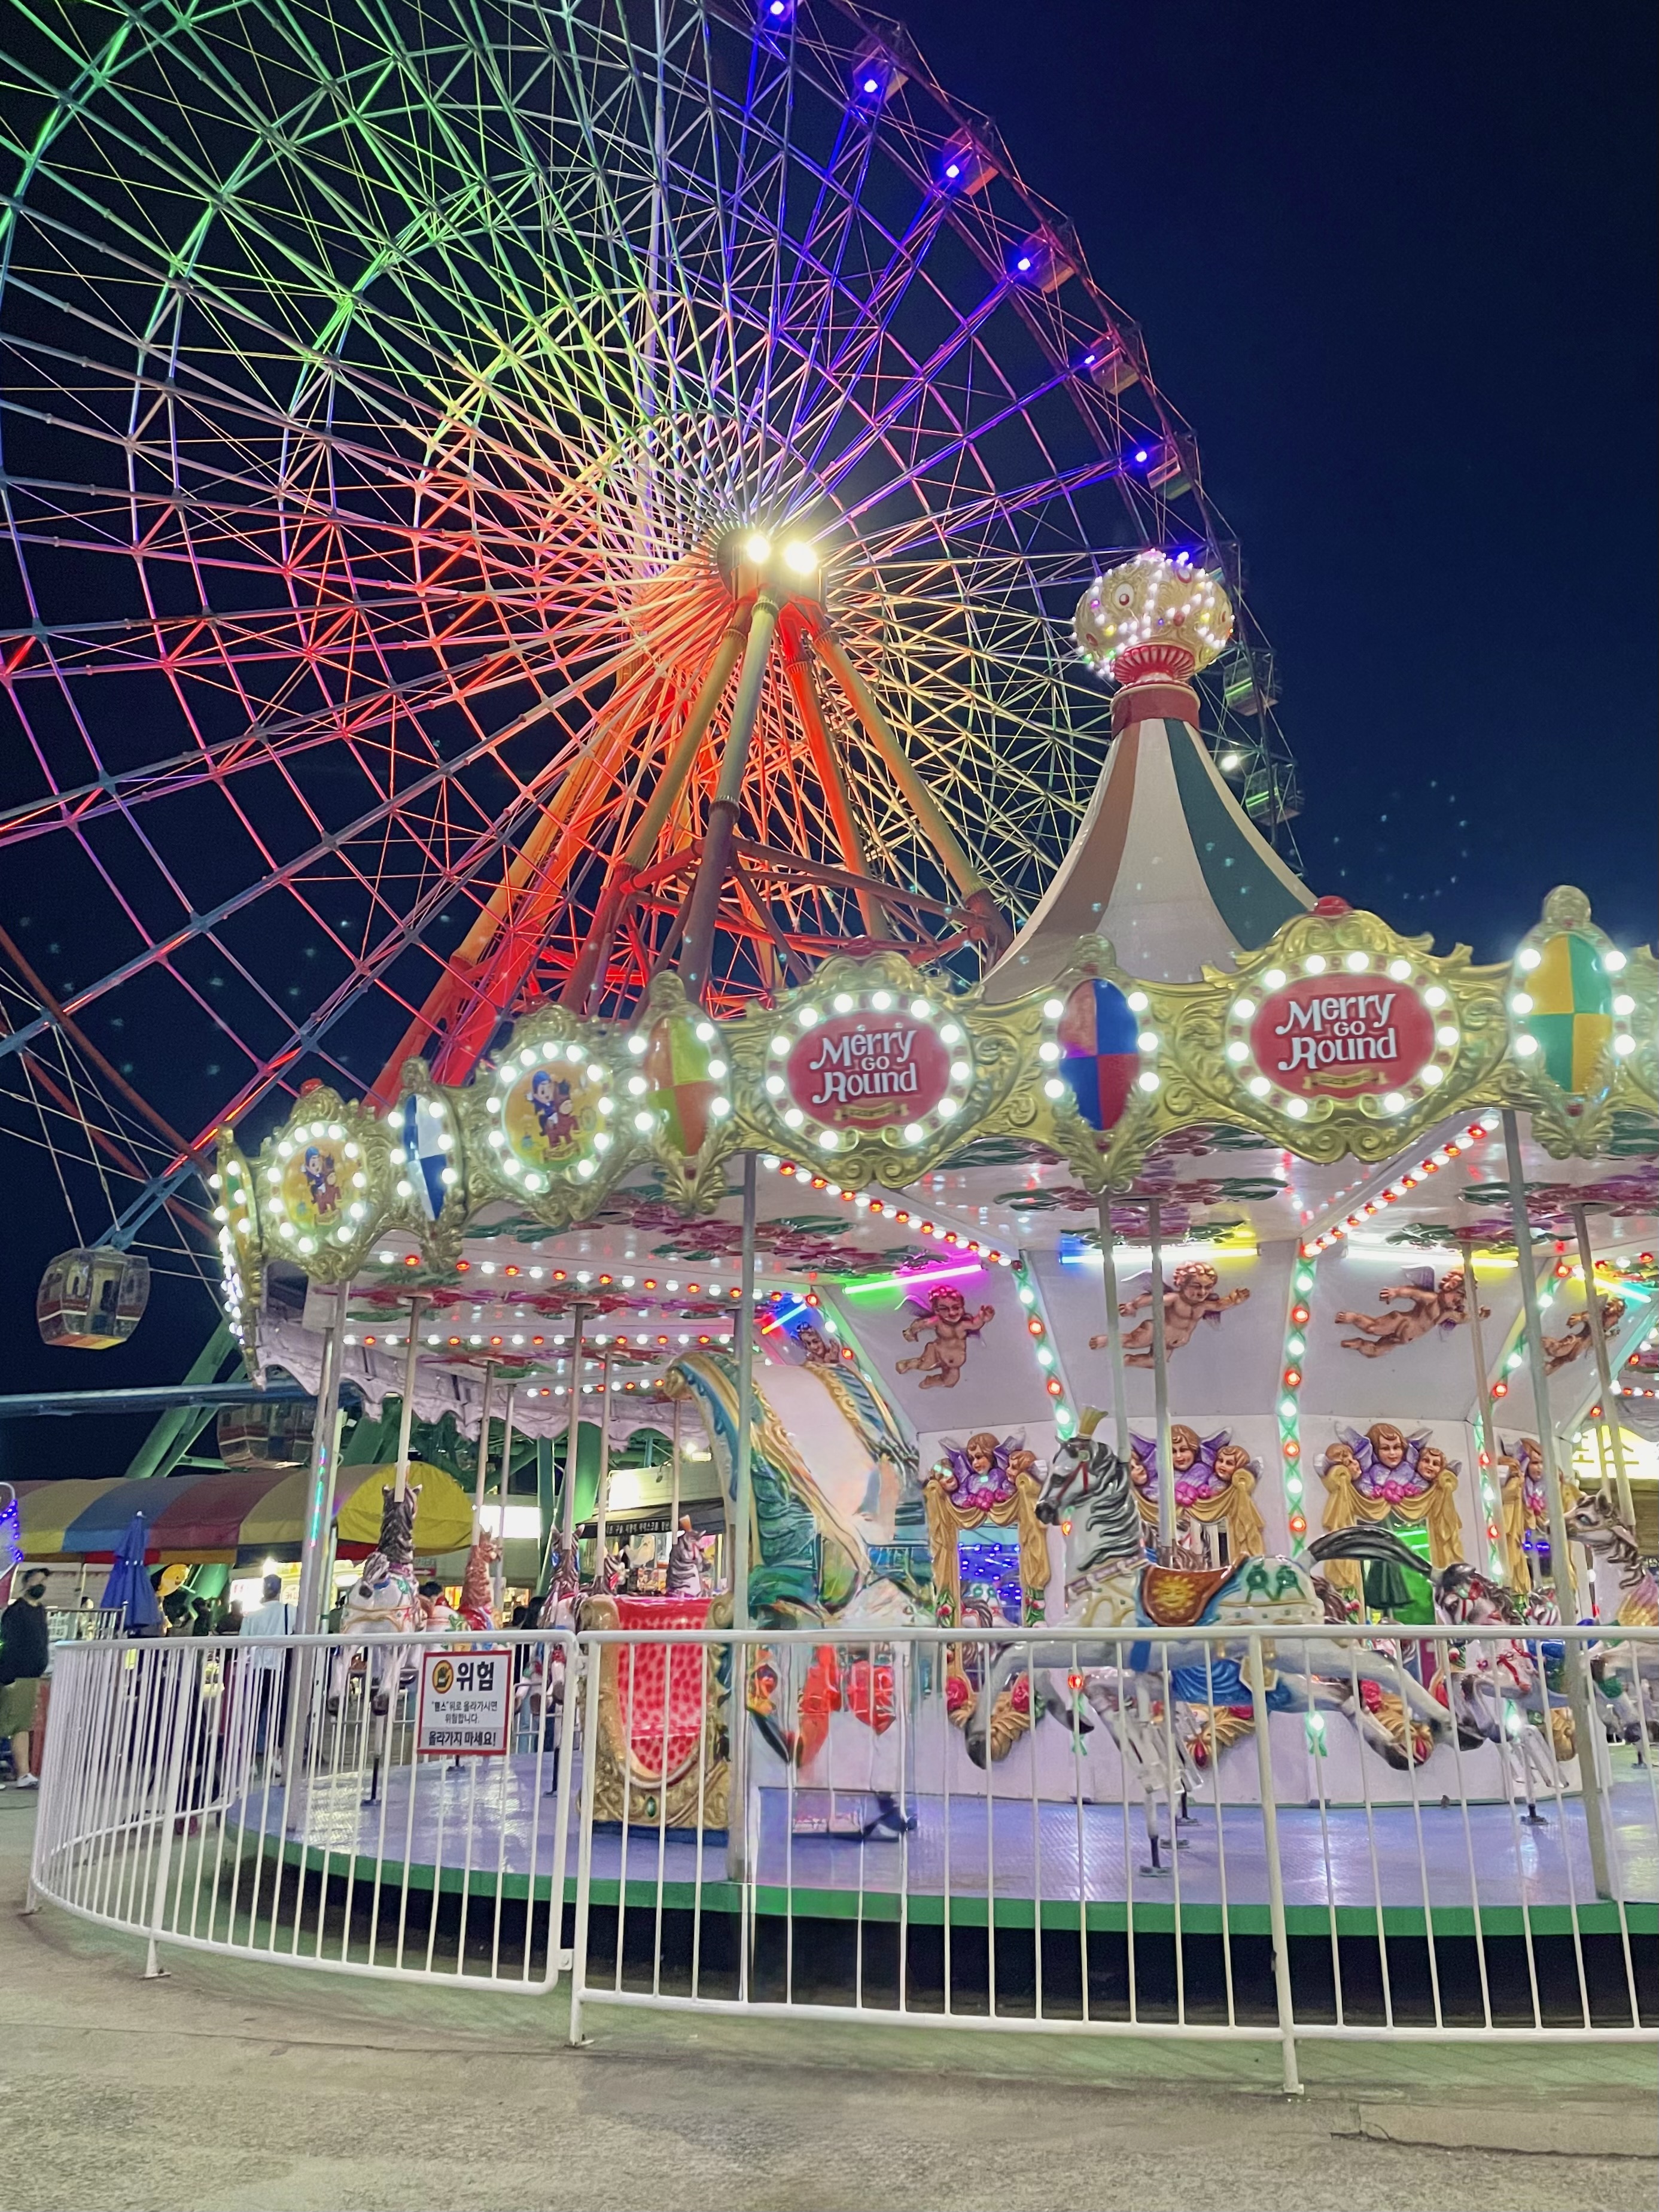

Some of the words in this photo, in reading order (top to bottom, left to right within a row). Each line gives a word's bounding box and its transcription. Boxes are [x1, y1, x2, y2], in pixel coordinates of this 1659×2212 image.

[1274, 993, 1396, 1035] Merry
[1334, 1021, 1366, 1036] GO
[809, 1030, 918, 1070] Merry
[1277, 1027, 1398, 1071] Round
[861, 1055, 890, 1071] GO
[812, 1062, 918, 1104] Round
[456, 1661, 495, 1691] 위험
[463, 1700, 498, 1712] 올라가시면
[445, 1713, 479, 1724] 위험합니다.
[428, 1730, 462, 1747] 올라가지
[464, 1730, 497, 1747] 마세요!
